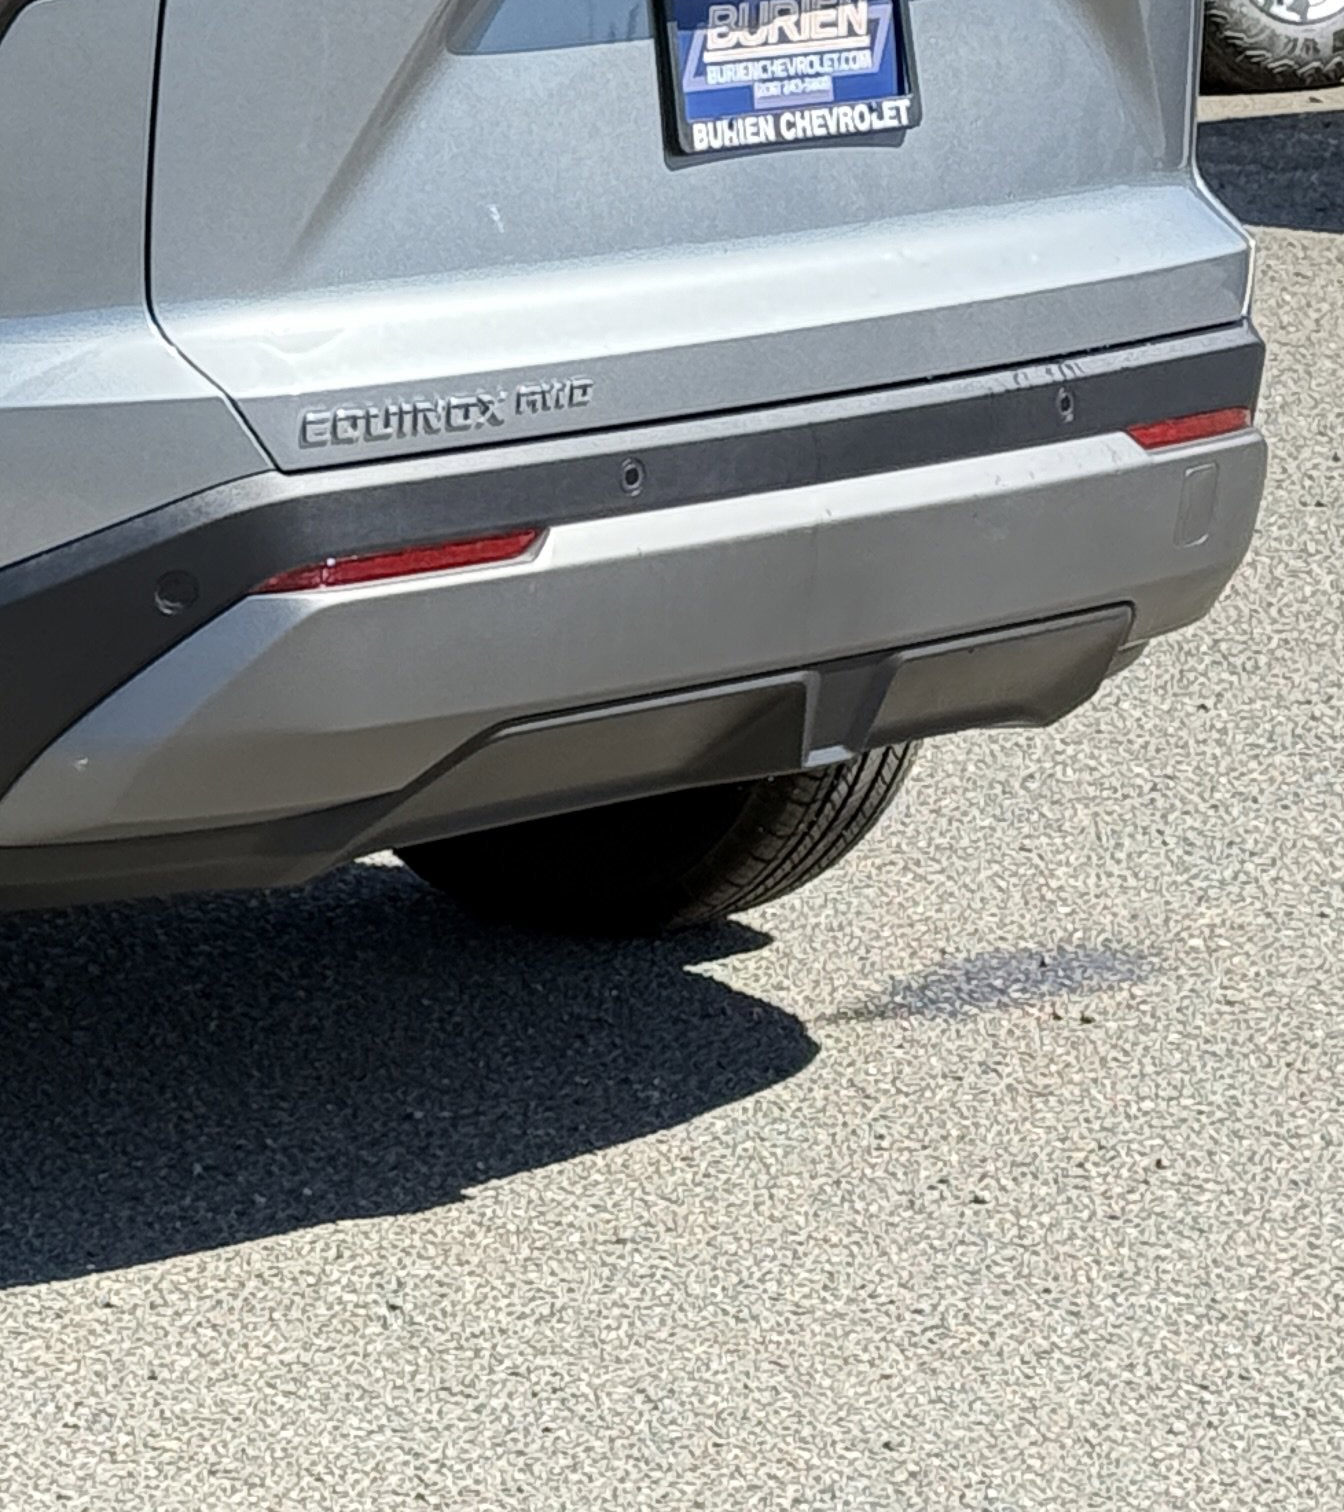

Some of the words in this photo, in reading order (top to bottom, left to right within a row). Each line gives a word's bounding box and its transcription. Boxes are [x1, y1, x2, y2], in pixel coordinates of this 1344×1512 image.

[706, 49, 872, 85] BURIENCHEVROLET.COM
[692, 114, 776, 151] BURIEN
[779, 98, 911, 141] CHEVROLET
[299, 390, 508, 449] EQUINOX
[514, 375, 595, 416] AWD
